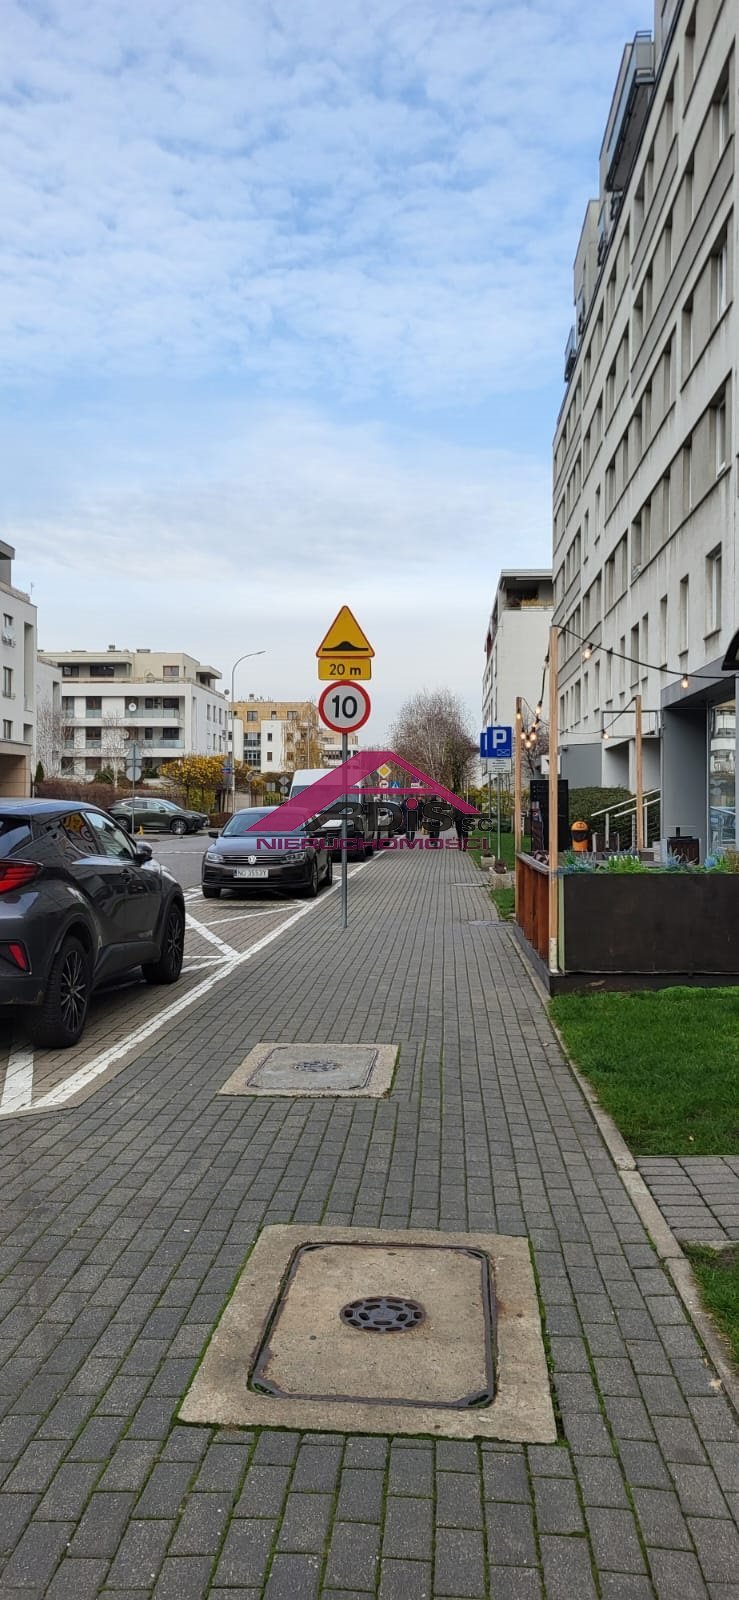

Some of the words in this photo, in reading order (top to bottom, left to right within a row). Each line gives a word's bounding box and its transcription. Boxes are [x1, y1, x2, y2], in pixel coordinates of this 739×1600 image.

[329, 663, 346, 676] 20
[350, 667, 361, 676] m
[331, 694, 358, 719] 10
[492, 729, 507, 749] P
